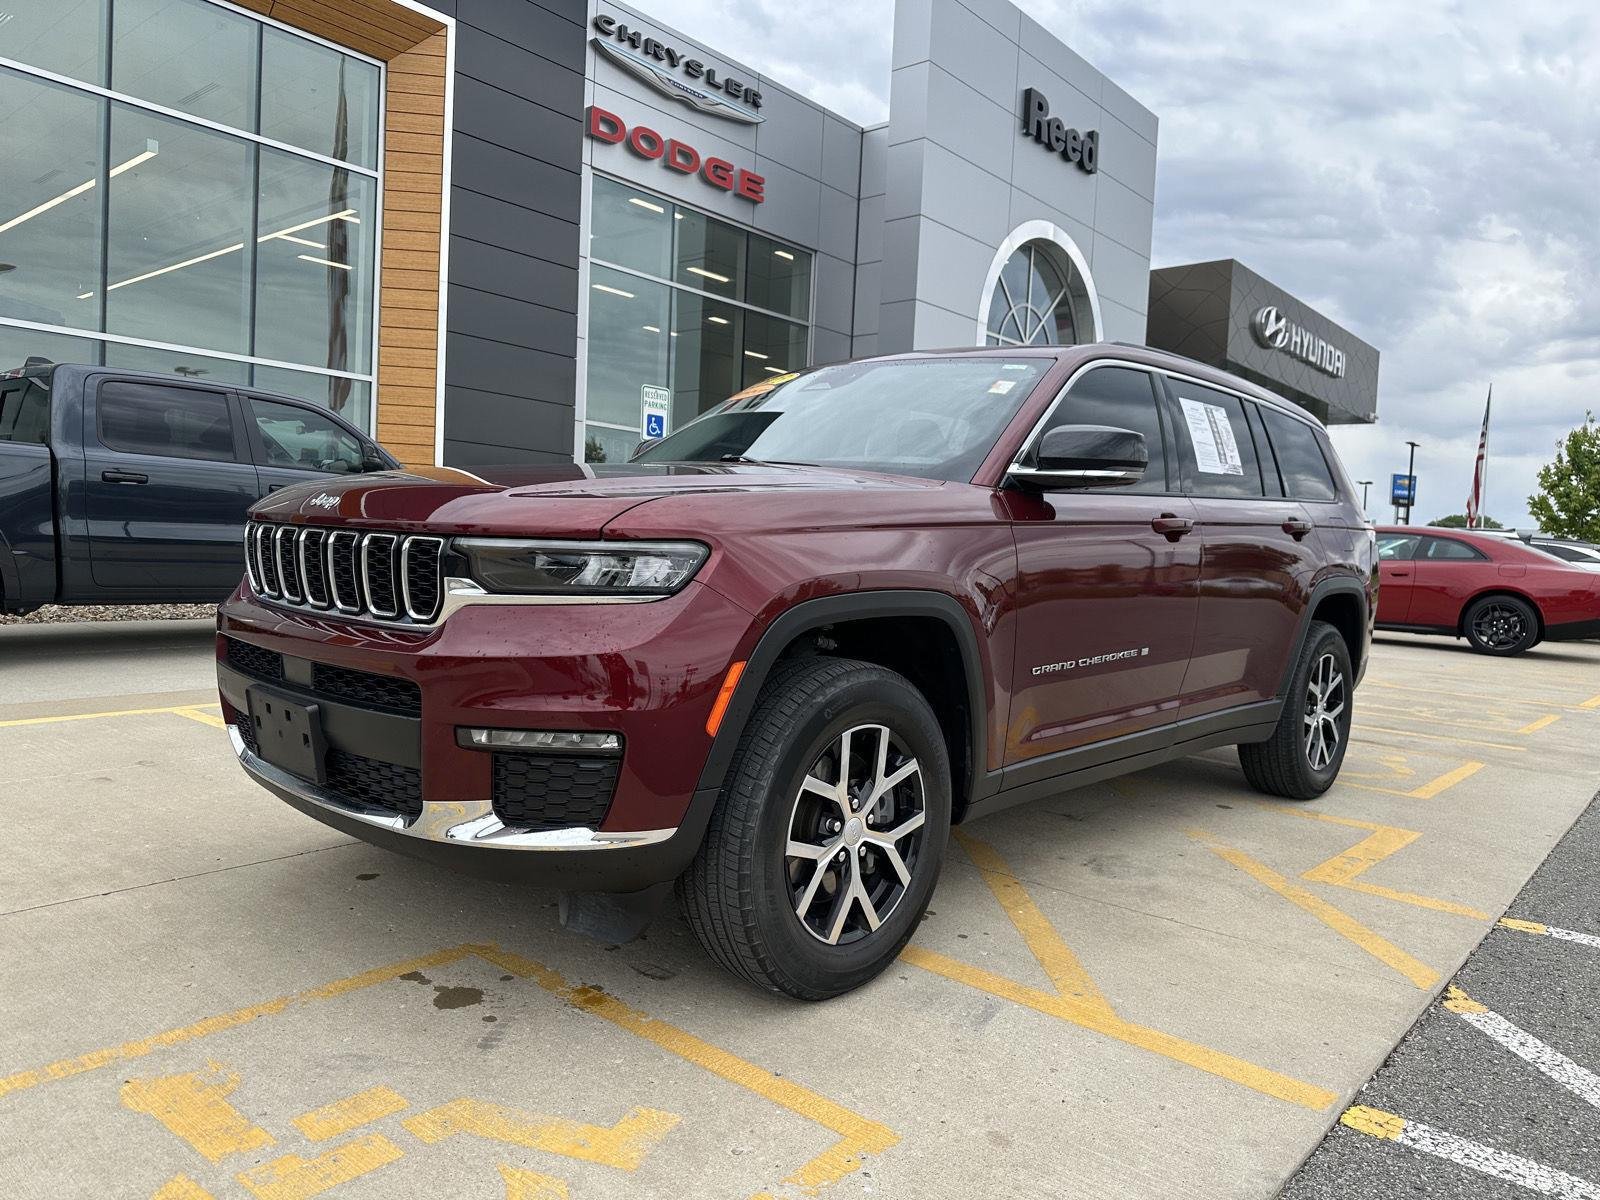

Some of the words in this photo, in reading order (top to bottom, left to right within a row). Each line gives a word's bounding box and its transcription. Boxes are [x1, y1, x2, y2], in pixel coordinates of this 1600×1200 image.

[594, 14, 763, 108] CHRYSLER
[1023, 87, 1099, 175] Reed
[586, 105, 766, 204] DODGE
[1289, 322, 1346, 379] HYUNDAI
[644, 390, 667, 402] RESERVED
[644, 400, 667, 411] PARKING
[310, 493, 340, 511] Jeep
[1031, 660, 1076, 676] GRAND
[1078, 649, 1138, 667] CHEROKEE
